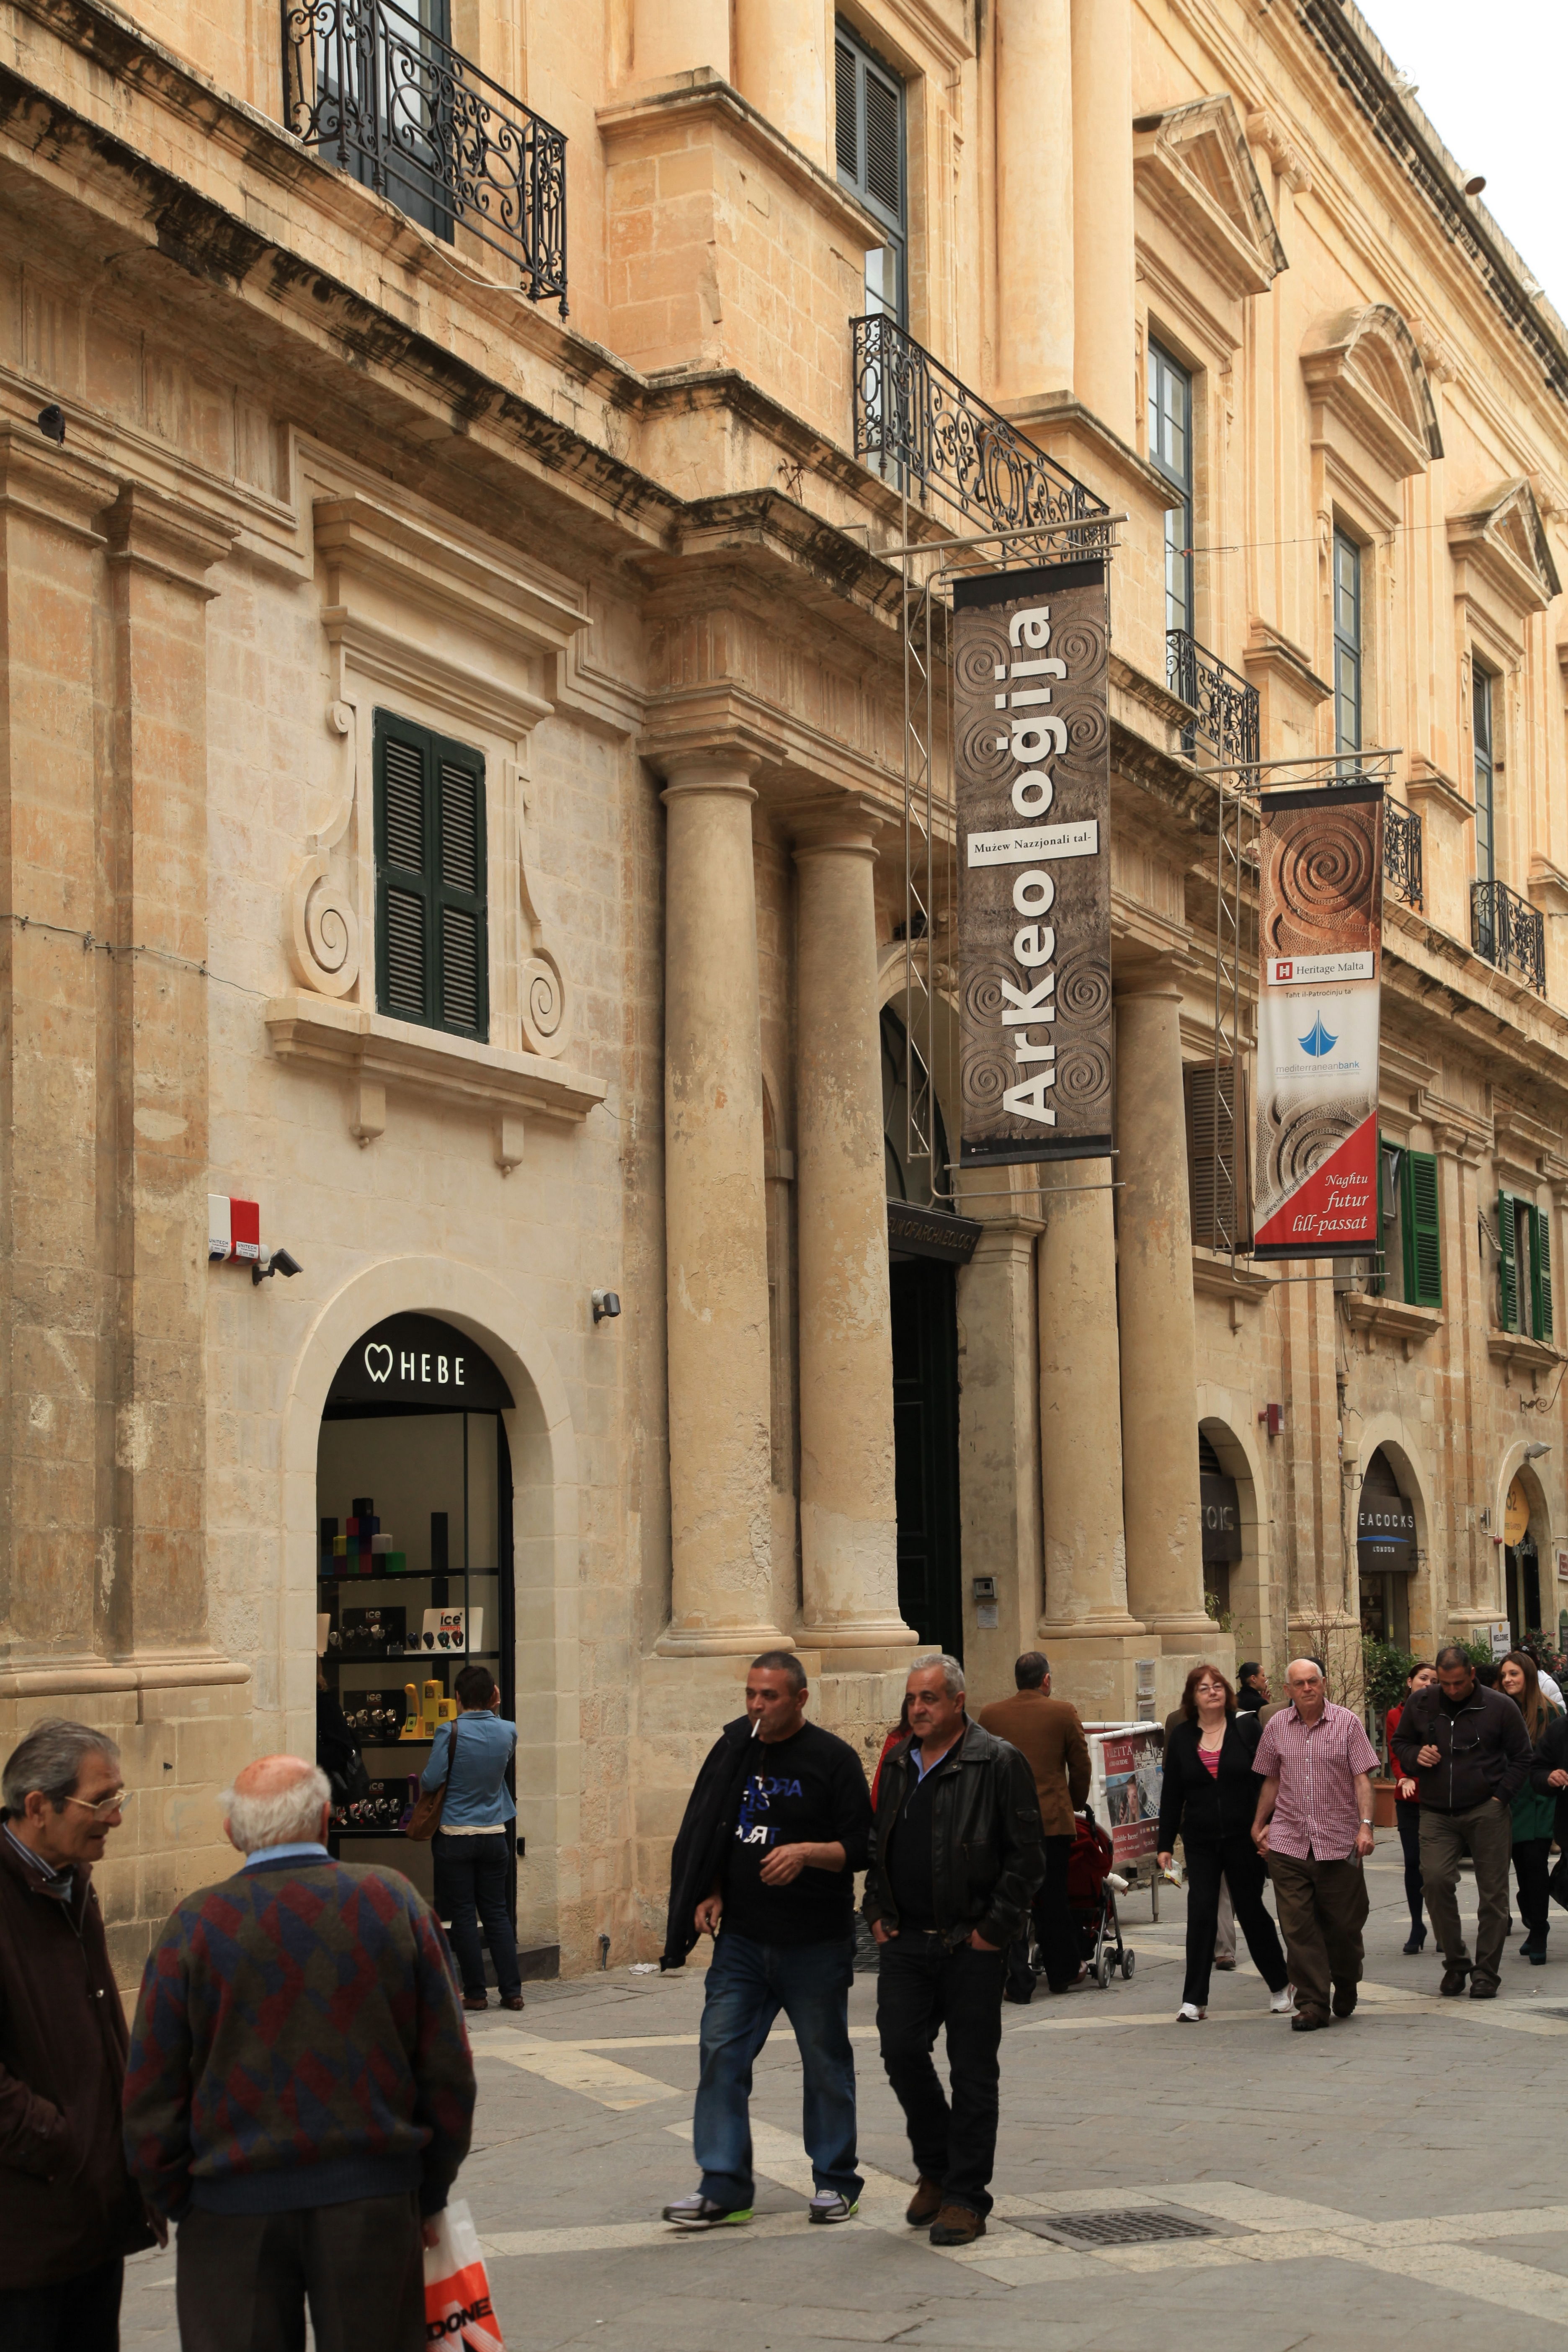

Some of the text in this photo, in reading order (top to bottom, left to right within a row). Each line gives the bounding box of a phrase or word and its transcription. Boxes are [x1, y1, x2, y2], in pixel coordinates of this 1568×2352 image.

[974, 832, 1091, 853] Mużew Nazzjonali tal-
[1296, 965, 1335, 975] Heritage
[1338, 962, 1364, 971] Malta
[1276, 1061, 1360, 1073] mediterraneanbank
[1264, 1160, 1319, 1216] www.heritagemalta.org
[1322, 1191, 1369, 1213] futur
[1292, 1214, 1368, 1236] lill-passat
[914, 1224, 977, 1251] ARCHAEOLOGY
[401, 1351, 464, 1385] HEBE
[440, 1612, 461, 1625] ice
[1493, 1634, 1509, 1642] WELCOME
